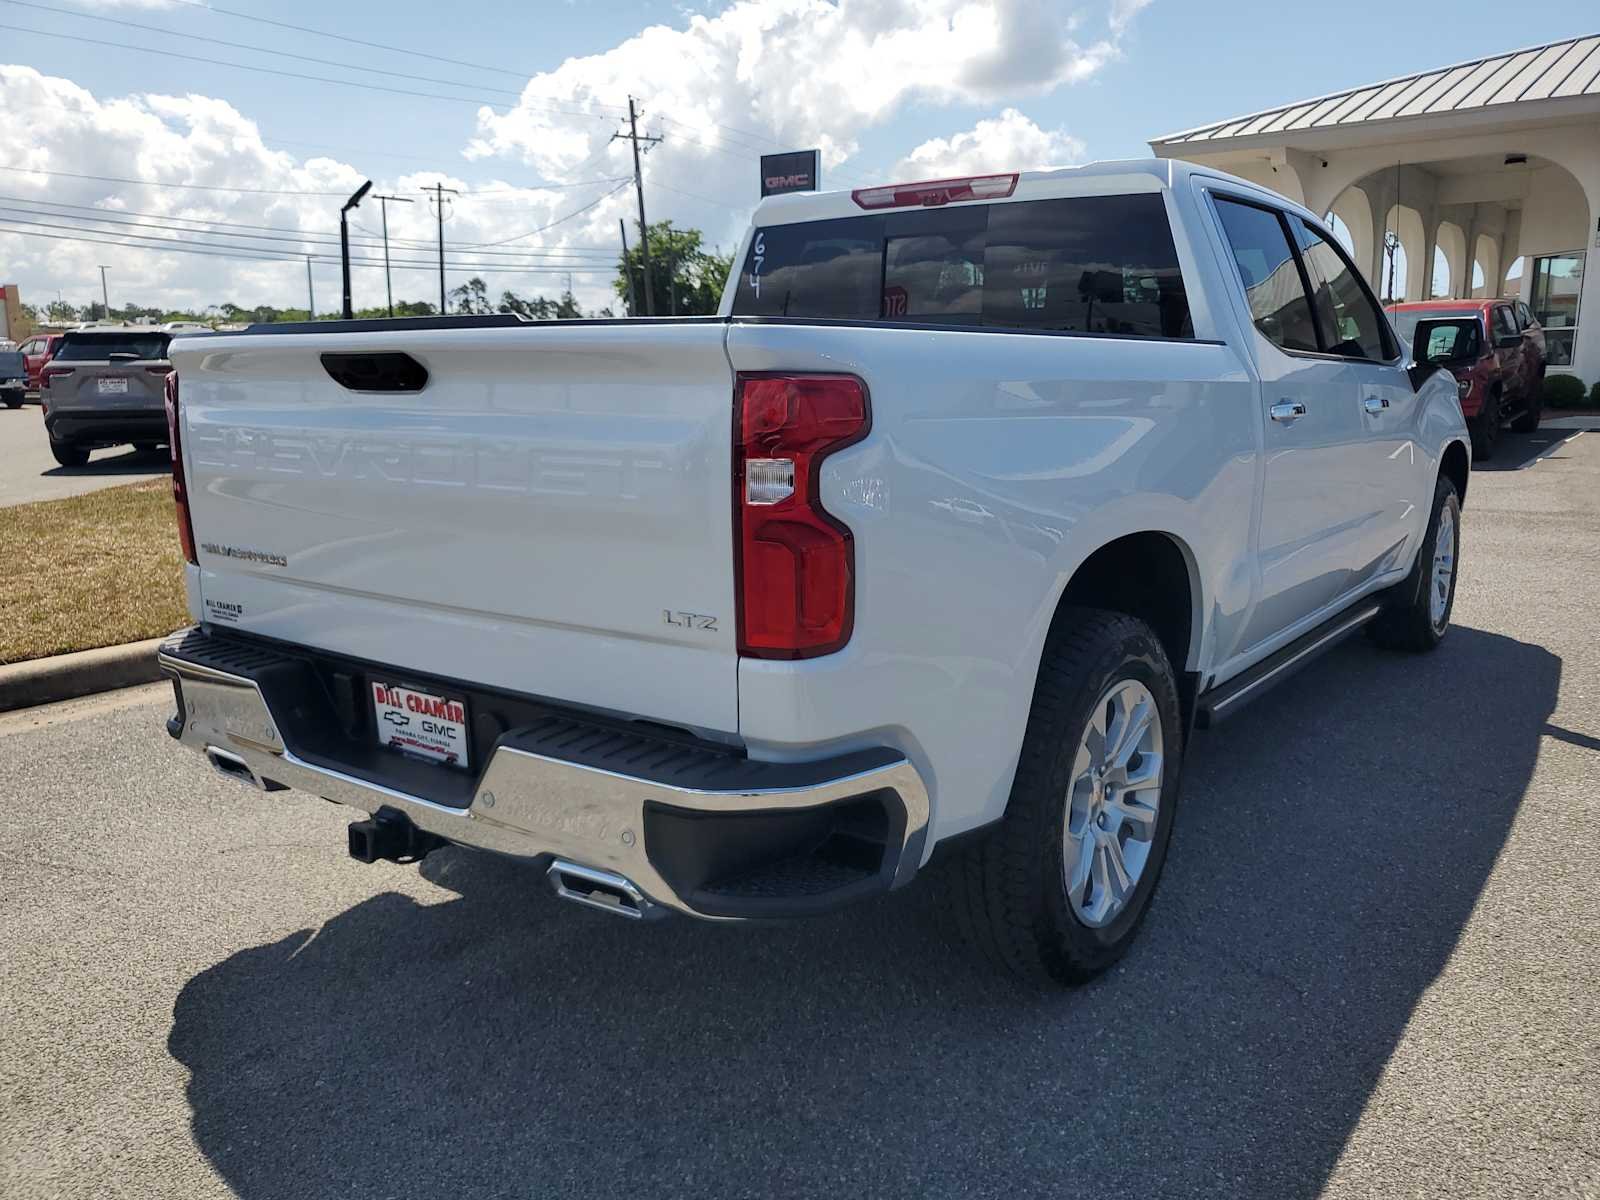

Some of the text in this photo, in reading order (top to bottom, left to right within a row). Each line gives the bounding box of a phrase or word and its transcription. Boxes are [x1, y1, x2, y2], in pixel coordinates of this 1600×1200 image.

[765, 174, 809, 188] GMC
[749, 232, 766, 299] 674
[663, 609, 719, 632] LTZ
[376, 686, 465, 725] BILL CRAMER
[422, 720, 457, 739] GMC
